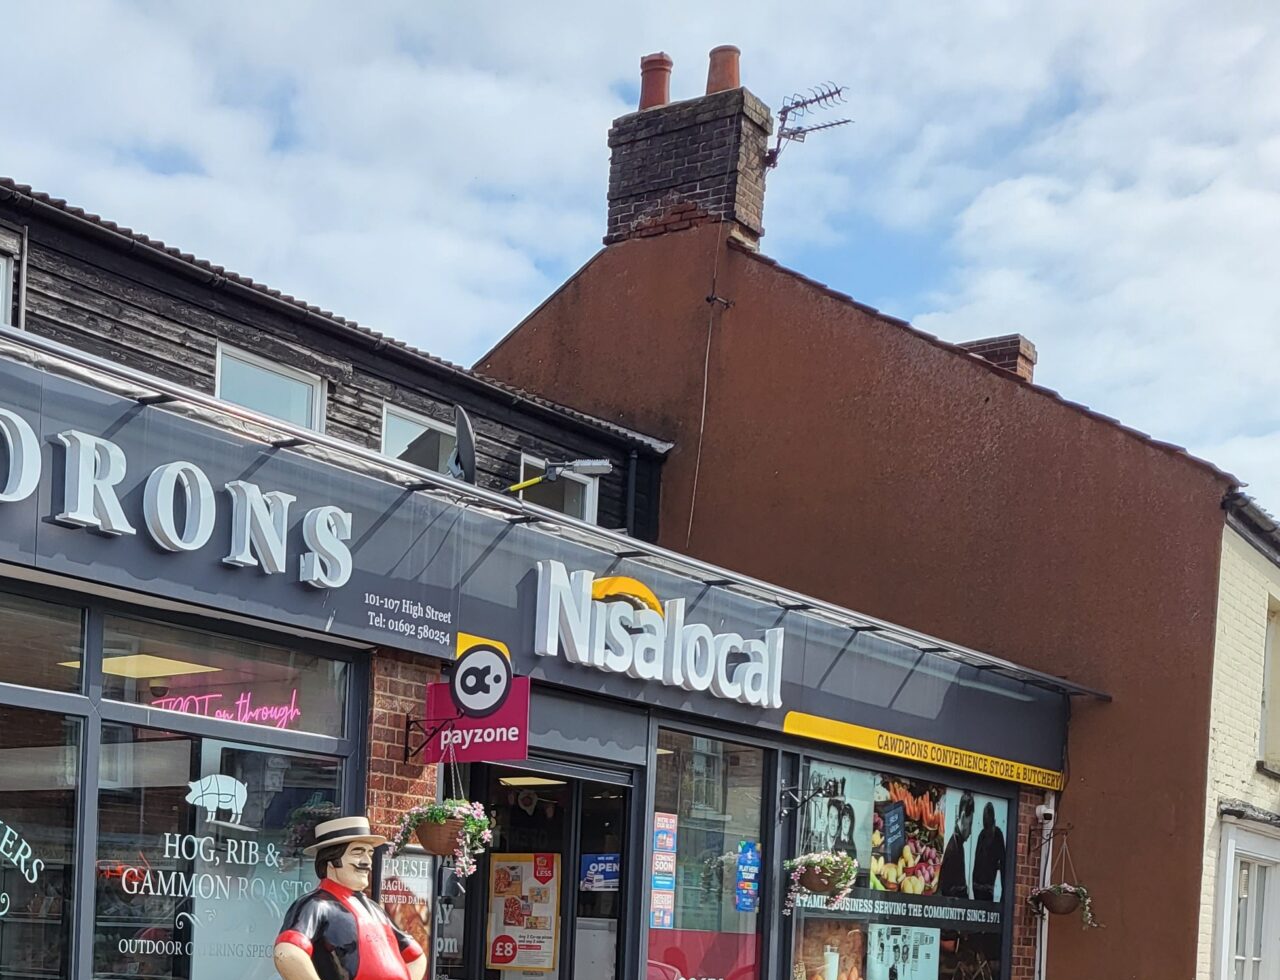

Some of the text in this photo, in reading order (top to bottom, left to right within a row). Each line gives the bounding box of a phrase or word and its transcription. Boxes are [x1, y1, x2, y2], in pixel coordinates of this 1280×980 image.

[364, 593, 452, 624] 101-107 High Street
[368, 611, 450, 646] Tel: 01692 580254
[235, 689, 301, 728] through
[440, 726, 519, 750] payzone
[877, 734, 1061, 788] CAWDRONS CONVENIENCE STORE & BUTCHERY
[163, 832, 281, 867] HOG, RIB &
[382, 859, 429, 878] FRESH
[589, 862, 619, 872] OPEN
[654, 861, 673, 871] SOON
[121, 867, 312, 903] GAMMON ROASTS
[380, 894, 407, 904] SERVED
[803, 894, 832, 911] FAMIL
[834, 899, 873, 913] BUSINESS
[874, 900, 906, 916] SERVING
[908, 903, 923, 917] THE
[924, 905, 966, 921] COMMUNITY
[967, 909, 986, 922] SINCE
[986, 912, 1000, 924] 1971
[118, 938, 182, 956] OUTDOOR
[185, 941, 245, 958] CTERING
[495, 942, 513, 956] £8
